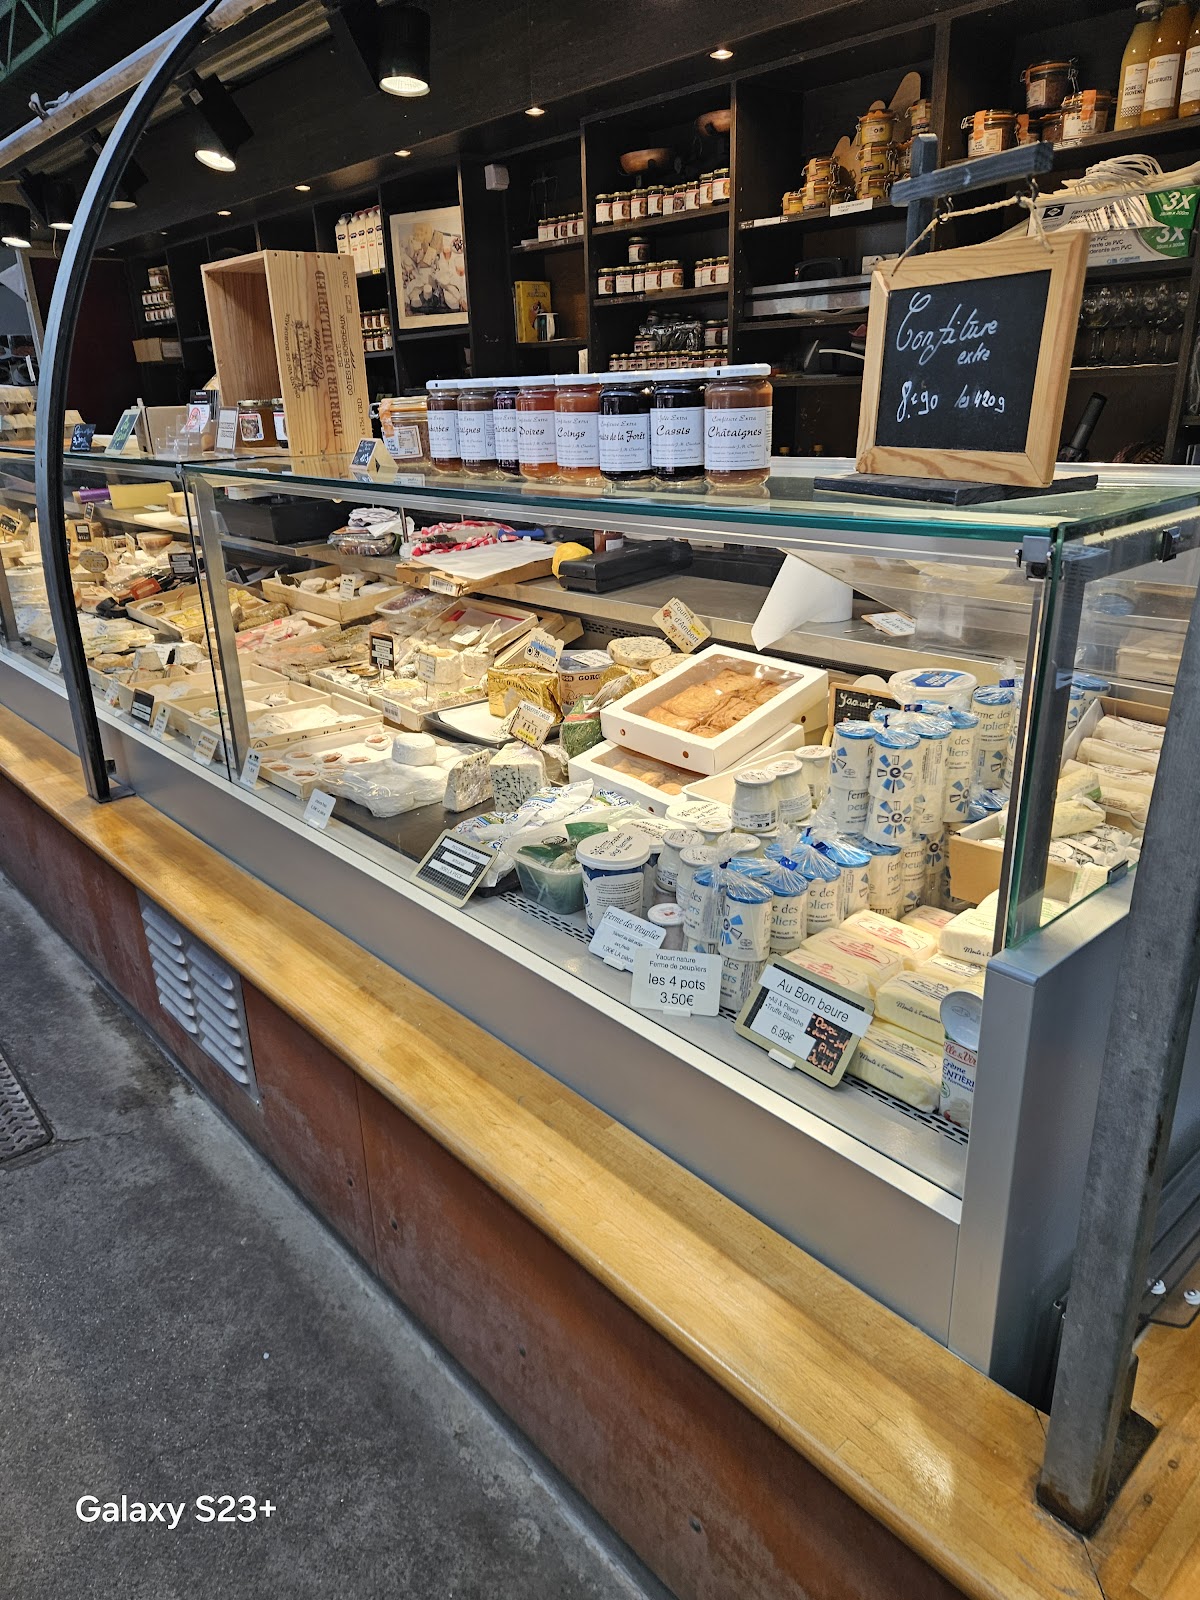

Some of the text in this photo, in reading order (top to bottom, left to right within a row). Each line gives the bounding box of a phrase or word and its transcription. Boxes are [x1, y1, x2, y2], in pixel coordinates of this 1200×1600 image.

[1162, 191, 1196, 211] 3X
[340, 314, 349, 357] BORDEAUX
[315, 270, 343, 437] TERRIER DE MILLEPIED
[344, 358, 350, 370] DE
[460, 427, 481, 435] aignes
[519, 426, 545, 438] Poires
[557, 427, 586, 440] Coings
[625, 430, 645, 442] Forêt
[656, 424, 691, 436] Cassis
[708, 425, 762, 440] Châtaignes
[838, 692, 874, 711] Yaourt
[819, 888, 835, 898] des
[781, 903, 799, 914] des
[603, 911, 623, 925] Ferme
[623, 919, 634, 929] des
[655, 953, 675, 962] Yaourt
[723, 957, 739, 970] des
[649, 961, 707, 973] Ferme de peupliers
[648, 972, 706, 991] les 4 pots
[660, 991, 694, 1007] 3.50€
[777, 978, 849, 1023] Au Bon beure
[770, 1024, 795, 1044] 6.99€
[943, 1058, 966, 1074] Crème
[964, 1051, 977, 1066] Vir
